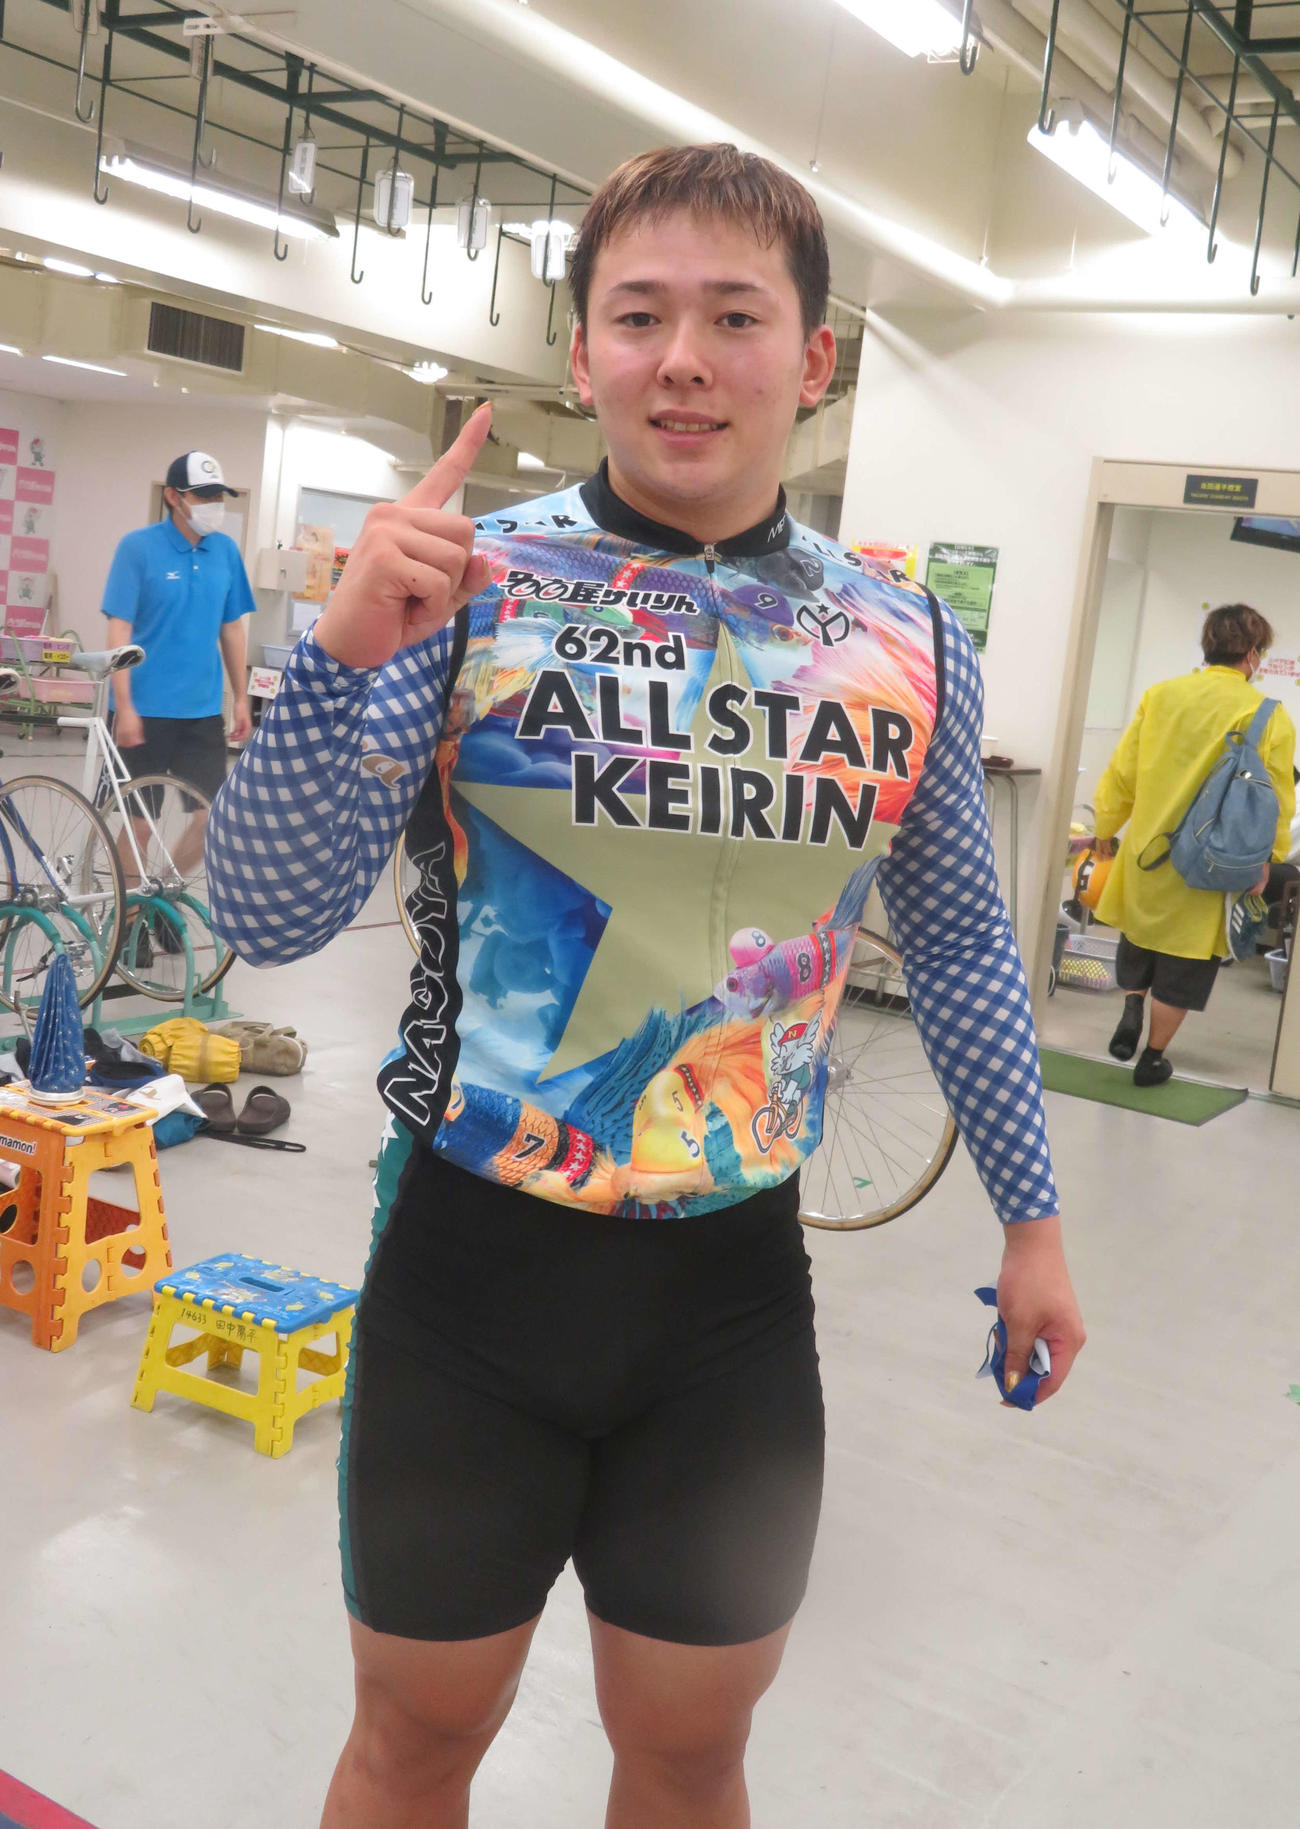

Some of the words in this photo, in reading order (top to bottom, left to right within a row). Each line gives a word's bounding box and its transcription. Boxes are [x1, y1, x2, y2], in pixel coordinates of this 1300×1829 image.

[501, 570, 699, 614] 名古屋けいりん
[554, 624, 686, 671] 62nd
[516, 669, 694, 752] ALL
[705, 682, 911, 780] STAR
[572, 751, 879, 849] KEIRIN
[796, 951, 812, 983] 8
[788, 1029, 798, 1040] N
[512, 1131, 547, 1161] 7
[680, 1129, 701, 1159] 5
